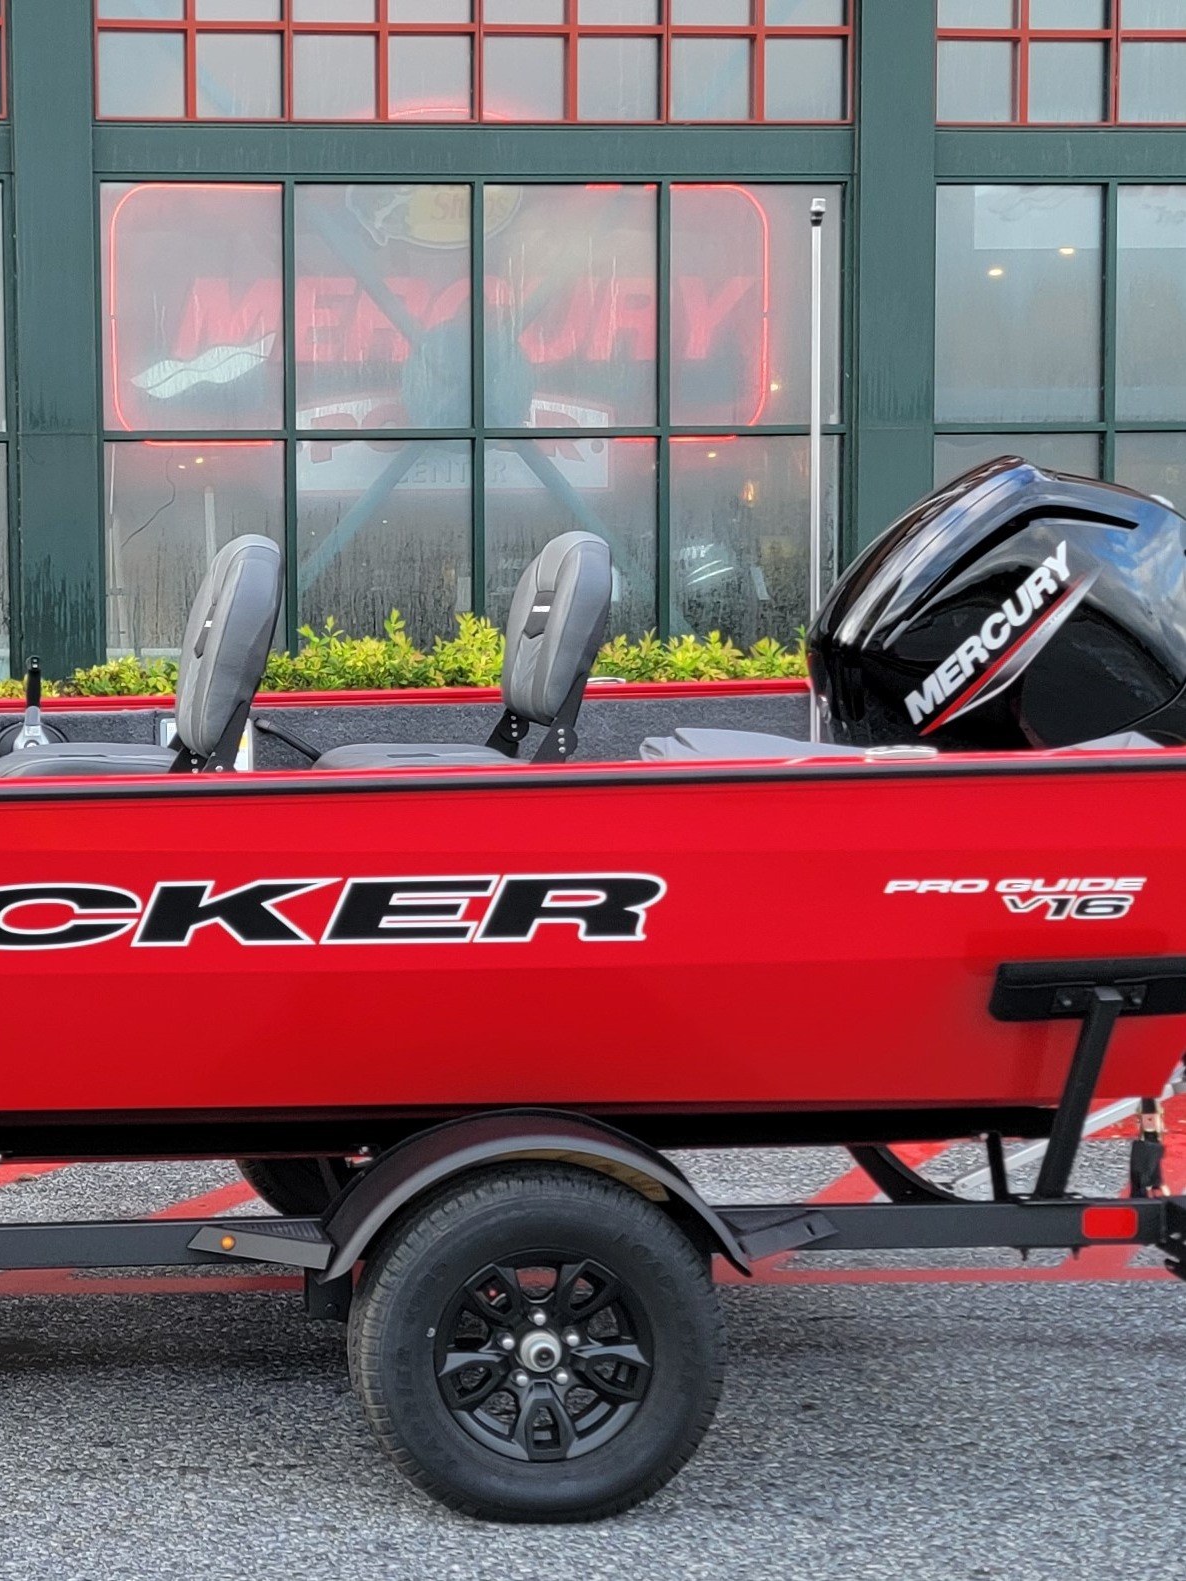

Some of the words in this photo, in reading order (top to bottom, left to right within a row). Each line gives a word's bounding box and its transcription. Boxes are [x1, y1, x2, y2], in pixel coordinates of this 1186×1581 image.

[904, 540, 1072, 725] MERCURY
[883, 878, 990, 894] PRO
[994, 876, 1148, 893] GUIDE
[1002, 894, 1135, 921] V16
